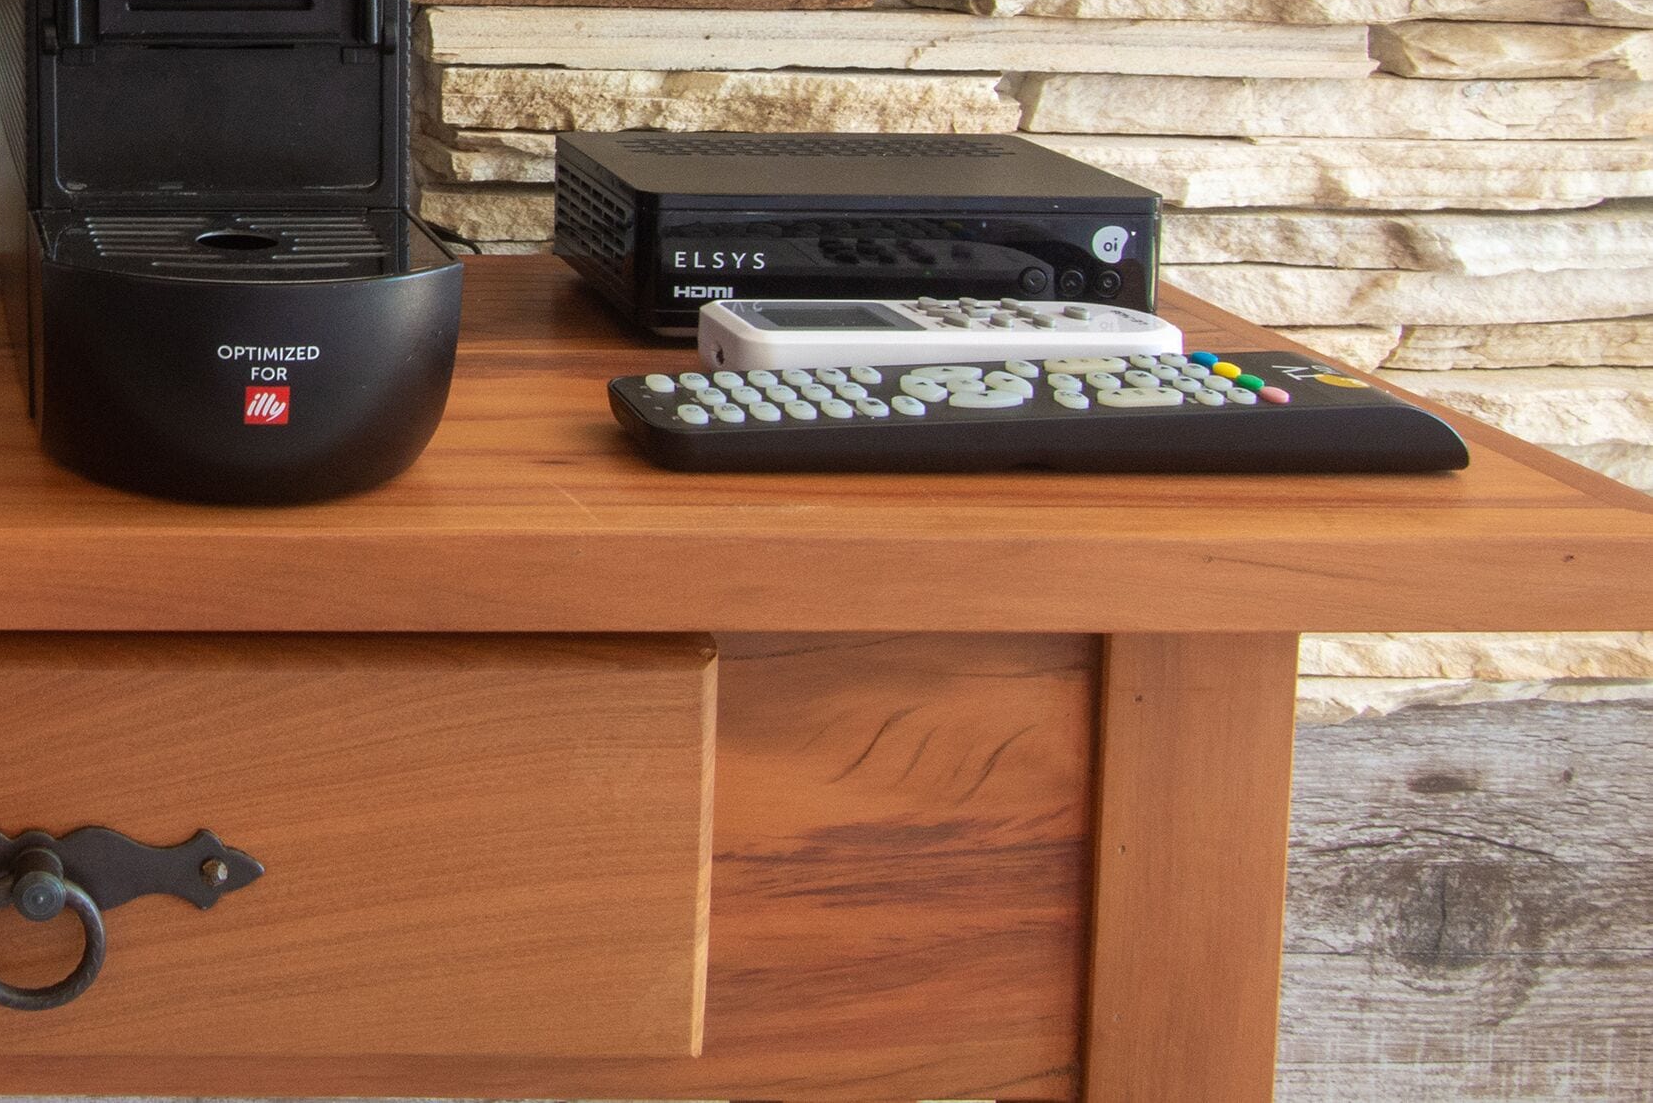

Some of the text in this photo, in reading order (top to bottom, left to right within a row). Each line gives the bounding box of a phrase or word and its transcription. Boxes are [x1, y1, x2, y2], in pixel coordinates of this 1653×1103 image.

[1103, 237, 1118, 252] oi
[674, 251, 766, 269] ELSYS
[673, 285, 734, 298] HDMI
[217, 345, 320, 361] OPTIMIZED
[251, 366, 288, 381] FOR
[246, 392, 287, 423] illy
